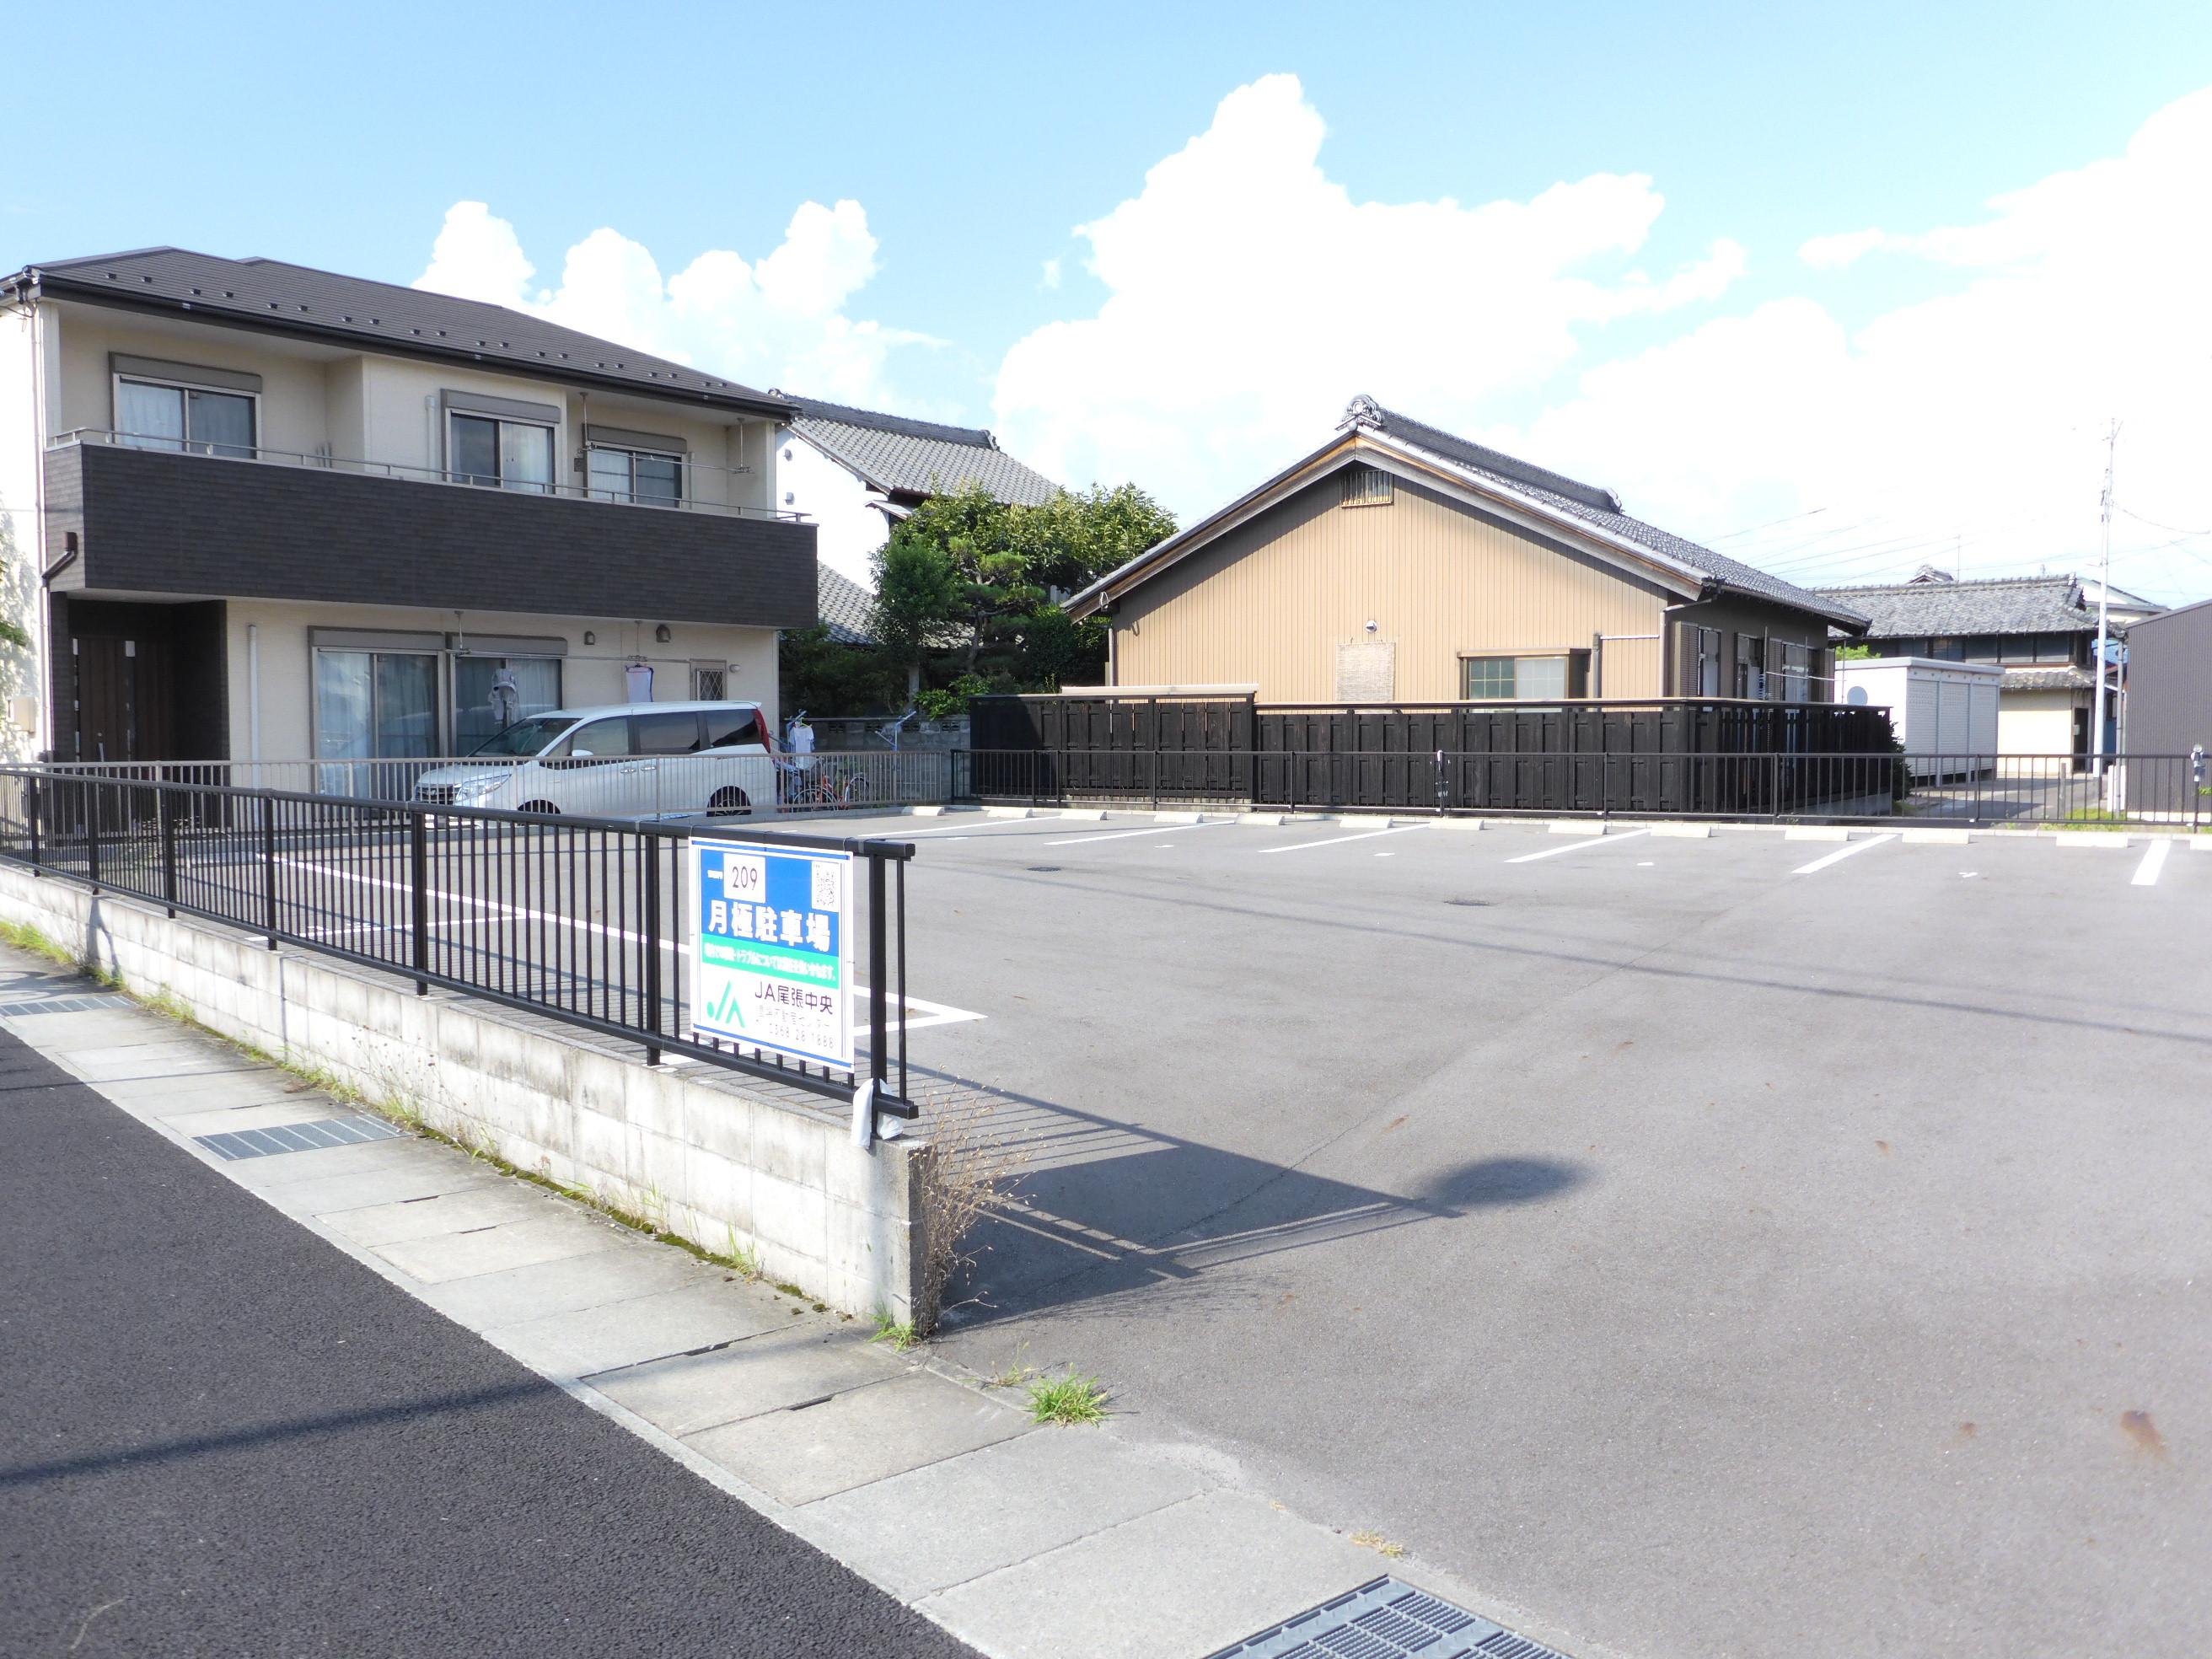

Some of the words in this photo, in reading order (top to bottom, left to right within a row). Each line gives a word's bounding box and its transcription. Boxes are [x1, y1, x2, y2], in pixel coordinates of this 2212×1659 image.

[732, 866, 758, 891] 209
[708, 899, 831, 953] 月極駐車場
[754, 980, 833, 1015] JA尾張中央
